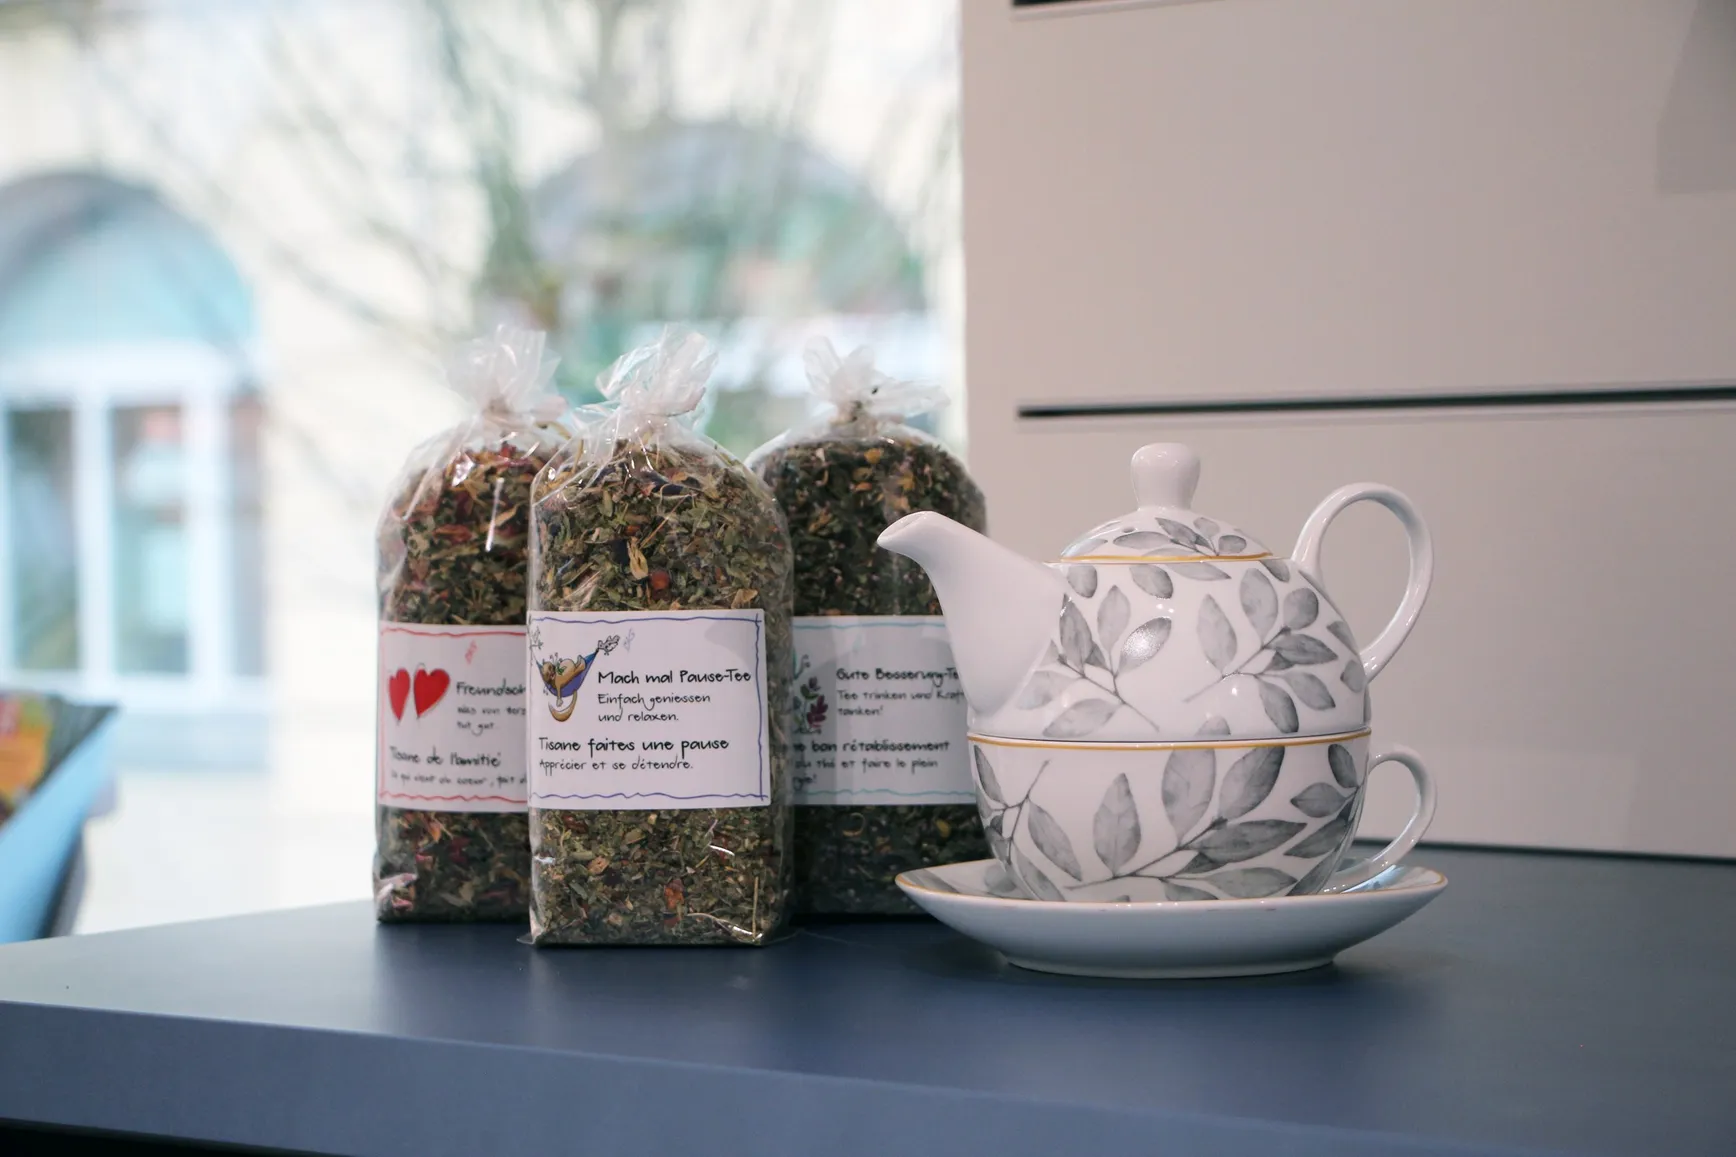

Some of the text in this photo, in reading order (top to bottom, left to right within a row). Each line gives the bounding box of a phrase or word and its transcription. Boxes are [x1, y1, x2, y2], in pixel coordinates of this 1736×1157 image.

[598, 668, 752, 684] Mach mal Pause-Tee
[836, 668, 960, 688] Gute Besserung-Te
[456, 677, 527, 697] Freundsch
[837, 689, 859, 700] Tee
[863, 689, 907, 700] trinken
[911, 685, 935, 700] und
[598, 693, 711, 711] Einfach geniessen
[598, 708, 679, 722] und relaxen.
[426, 744, 443, 765] de
[538, 737, 729, 759] Tisane faites une pause
[812, 740, 837, 752] bon
[843, 739, 950, 752] rétablissement
[539, 755, 694, 776] Apprécier et se détendre.
[841, 760, 856, 768] et
[862, 758, 892, 773] faire
[897, 757, 907, 768] le
[911, 758, 938, 774] plein
